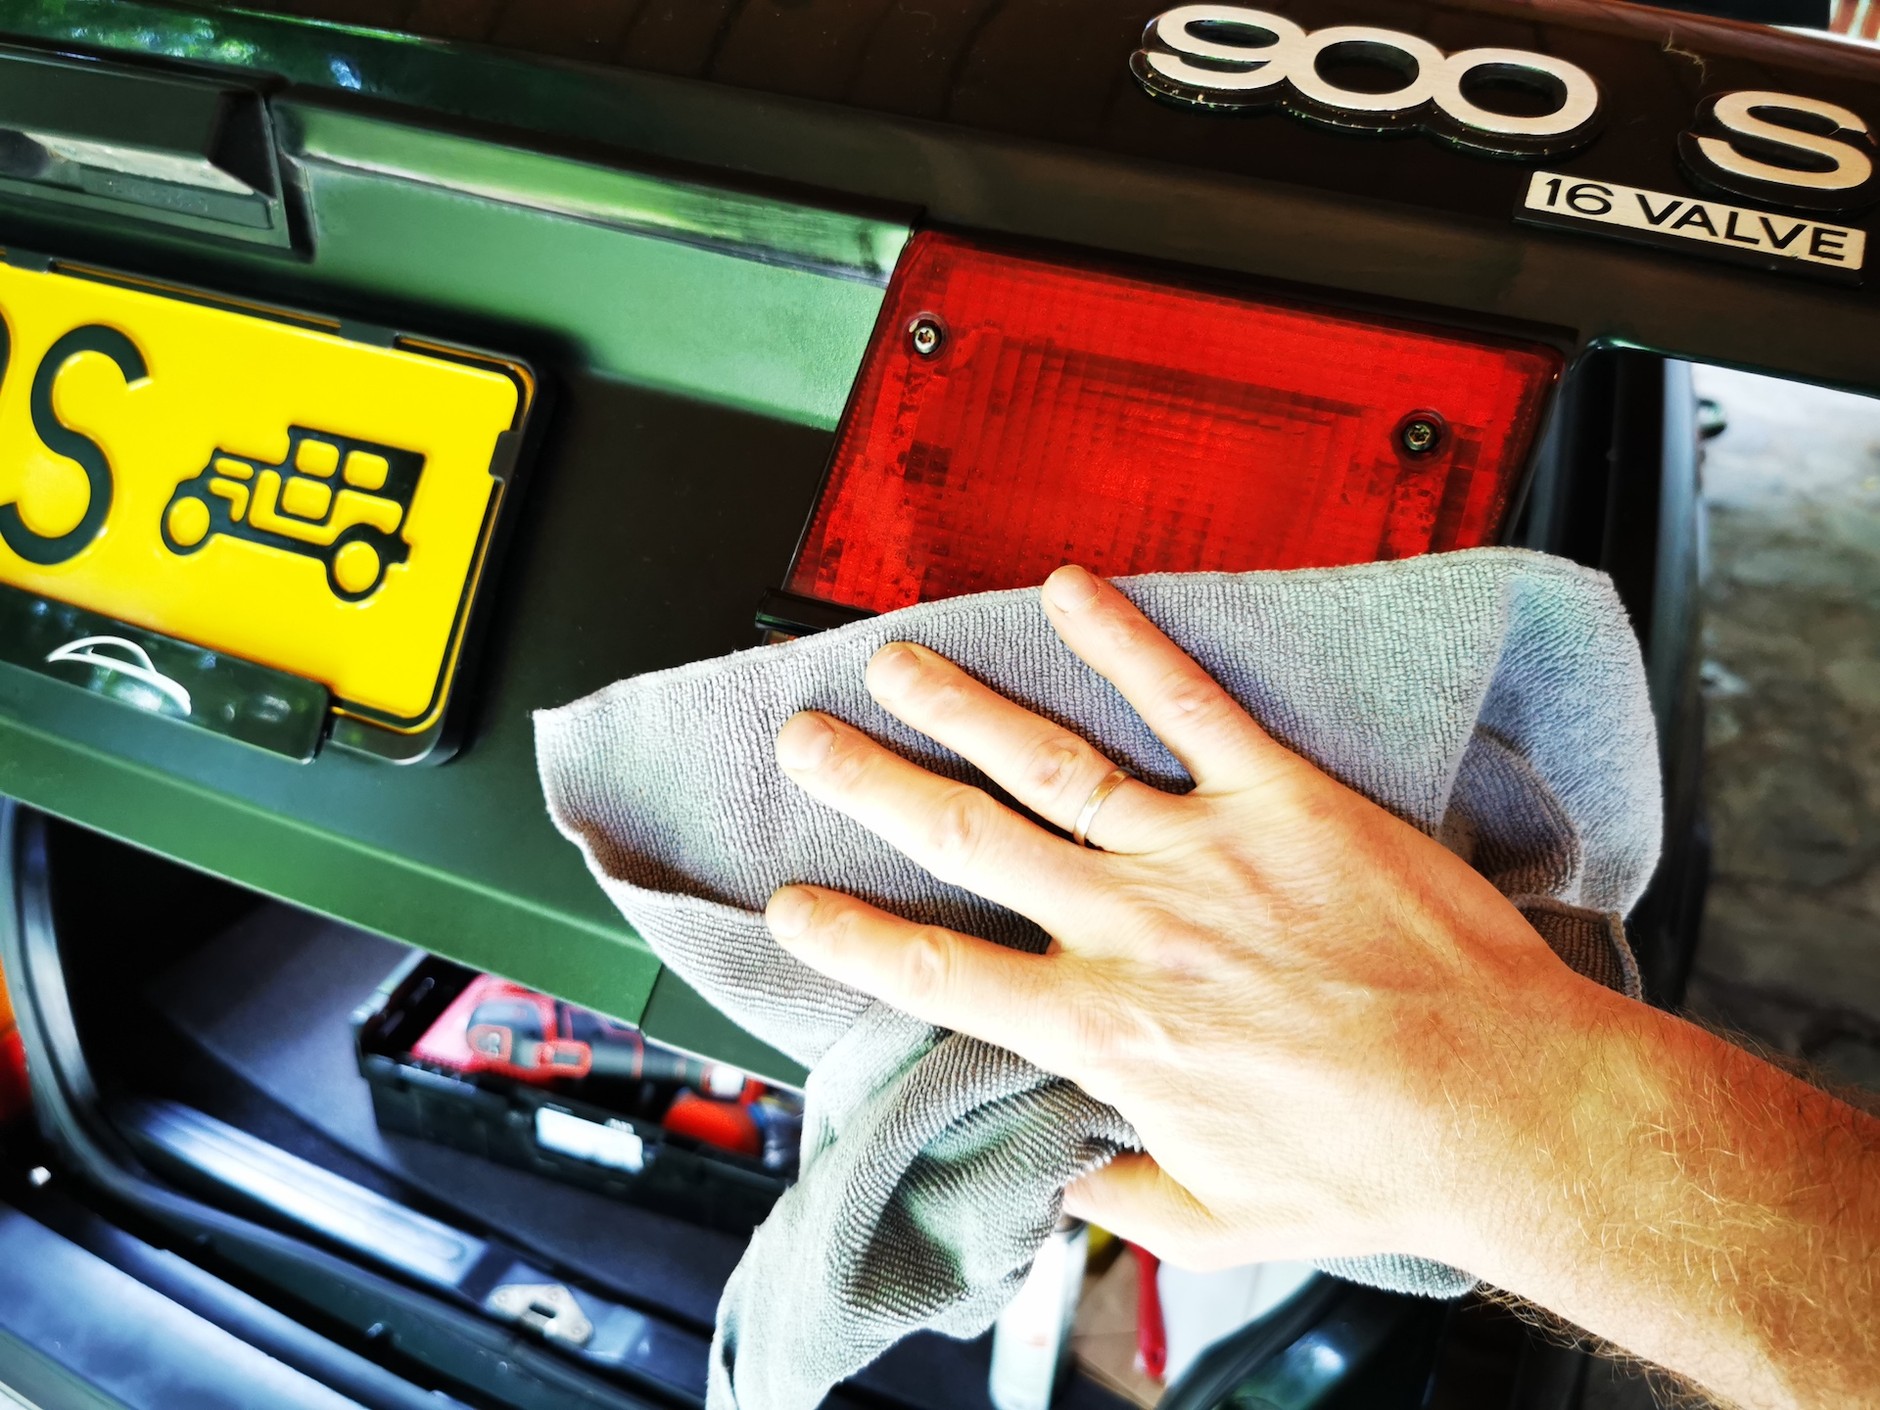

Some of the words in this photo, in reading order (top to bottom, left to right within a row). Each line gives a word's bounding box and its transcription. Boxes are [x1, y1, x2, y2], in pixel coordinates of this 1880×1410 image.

[1141, 4, 1600, 140] 900
[1695, 89, 1875, 192] S
[1545, 177, 1614, 216] 16
[1634, 192, 1850, 262] VALVE
[0, 308, 151, 566] S
